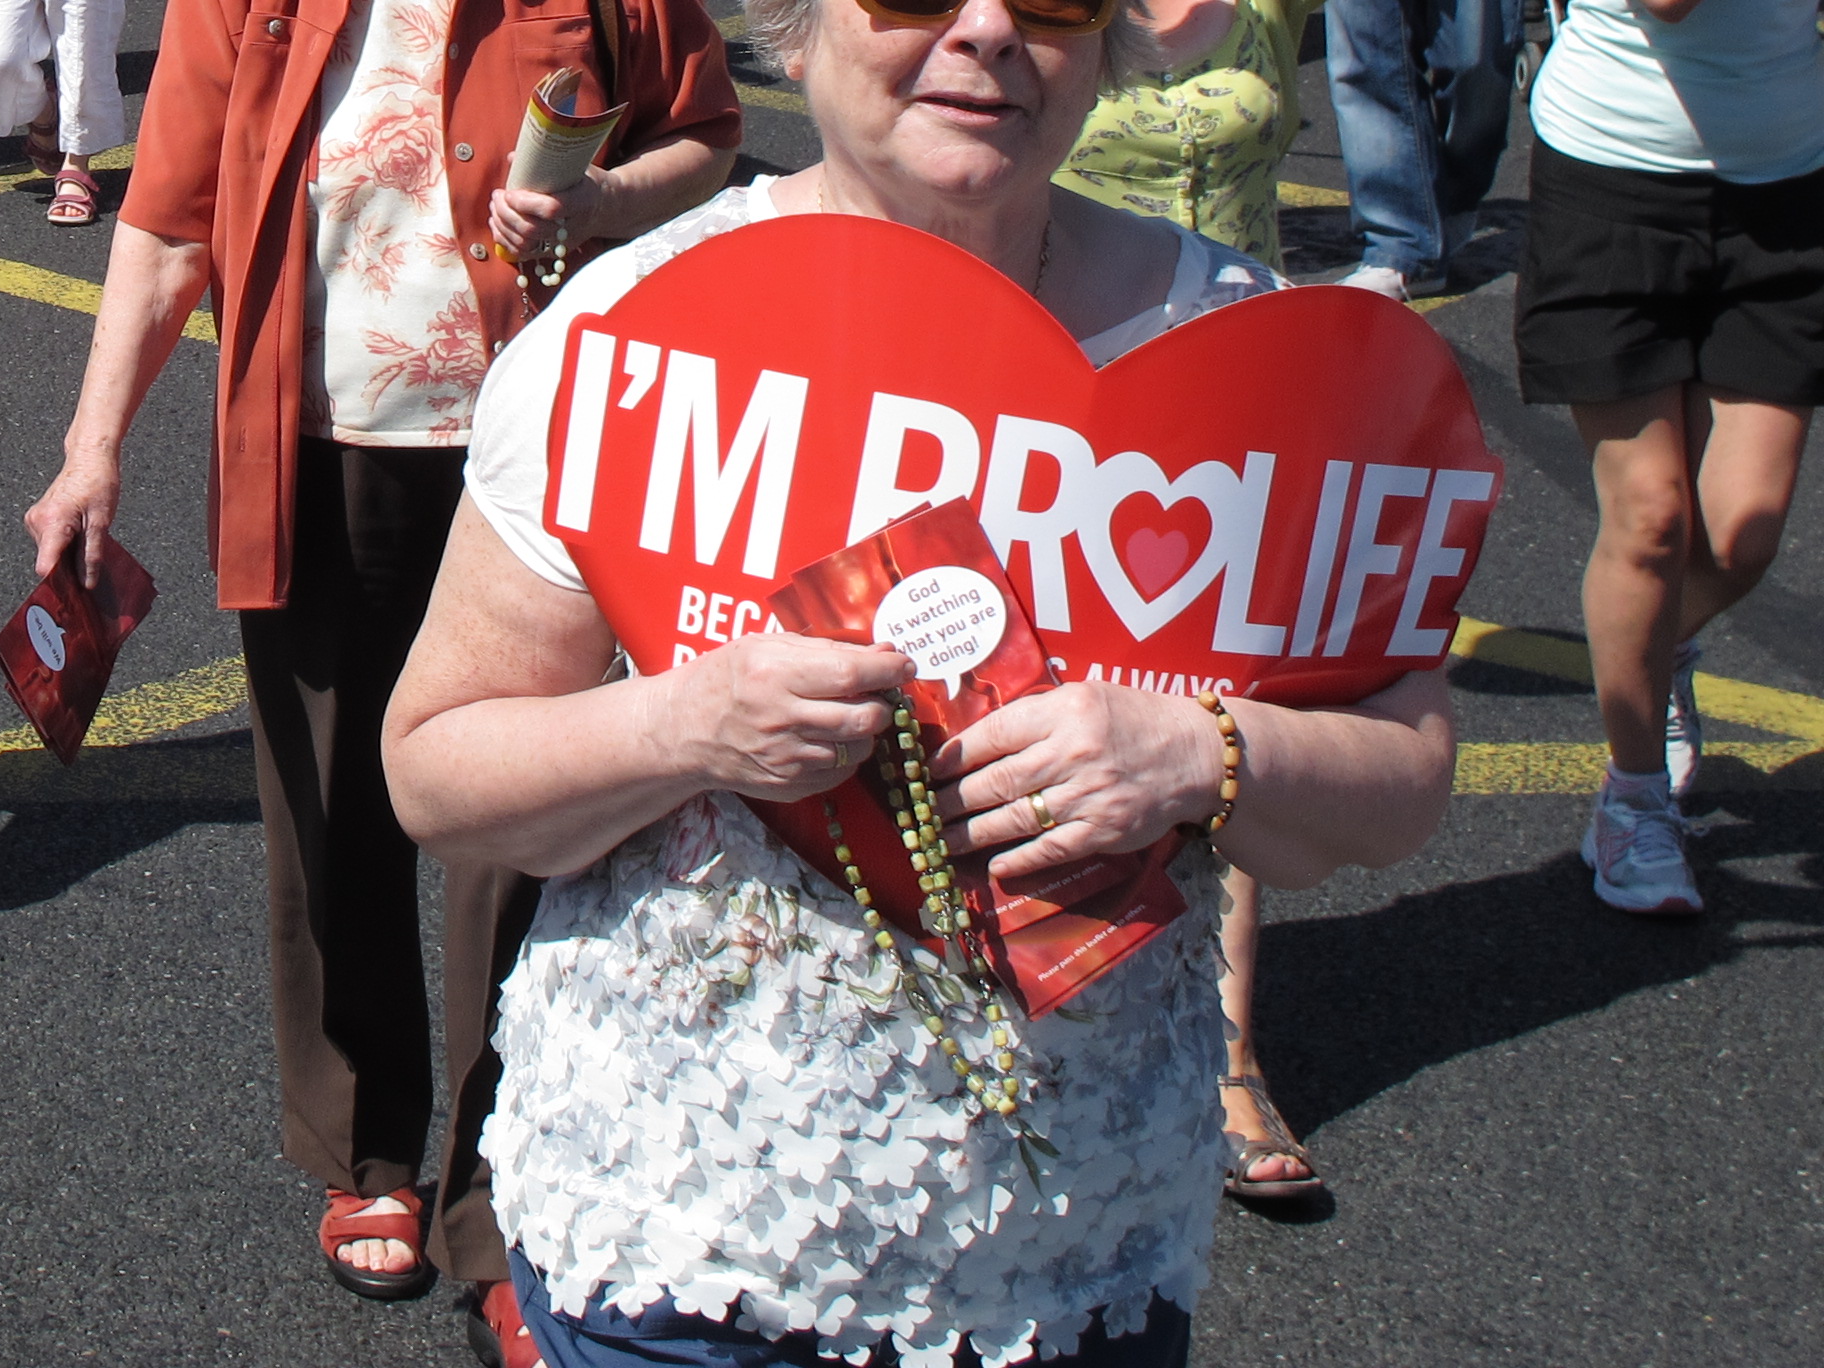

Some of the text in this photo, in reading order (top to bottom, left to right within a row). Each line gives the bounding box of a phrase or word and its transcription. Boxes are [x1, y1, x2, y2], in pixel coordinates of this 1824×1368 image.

[555, 327, 1495, 659] I'M PROLIFE
[907, 578, 941, 603] God
[887, 588, 982, 638] is watching
[935, 618, 967, 643] you
[969, 605, 997, 626] are
[928, 635, 981, 668] doing!
[1037, 963, 1061, 983] Please
